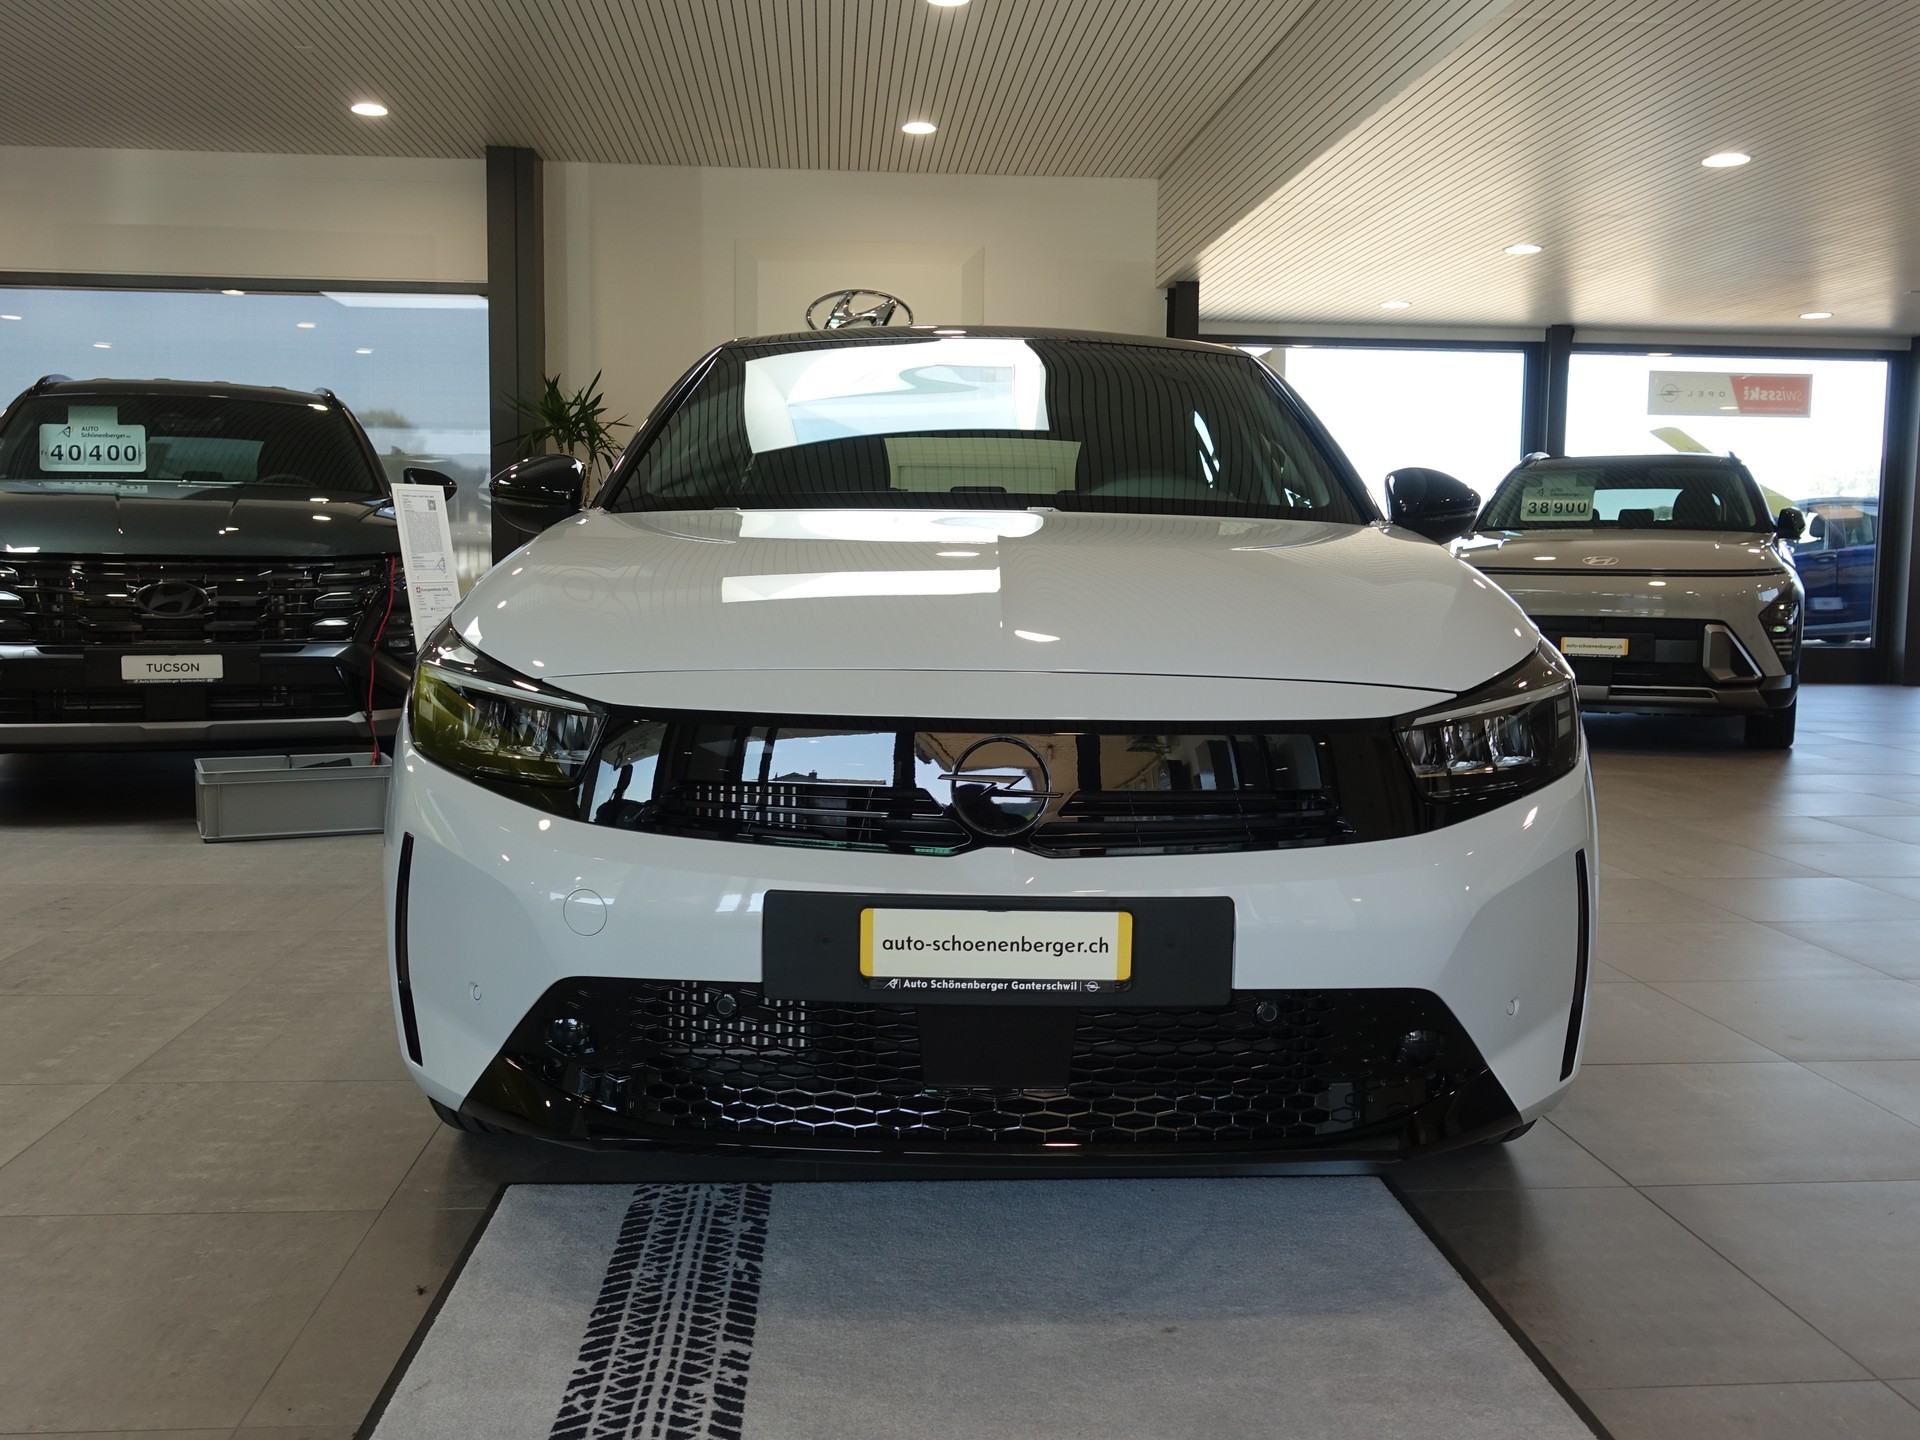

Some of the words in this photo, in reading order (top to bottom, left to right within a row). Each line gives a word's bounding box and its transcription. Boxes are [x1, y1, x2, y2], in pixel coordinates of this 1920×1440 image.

[146, 663, 200, 672] TUCSON
[882, 935, 1109, 957] auto-schoenenberger.ch
[903, 980, 928, 990] Auto
[930, 980, 1008, 993] Schönenberger
[1011, 981, 1077, 992] Ganterschwil
